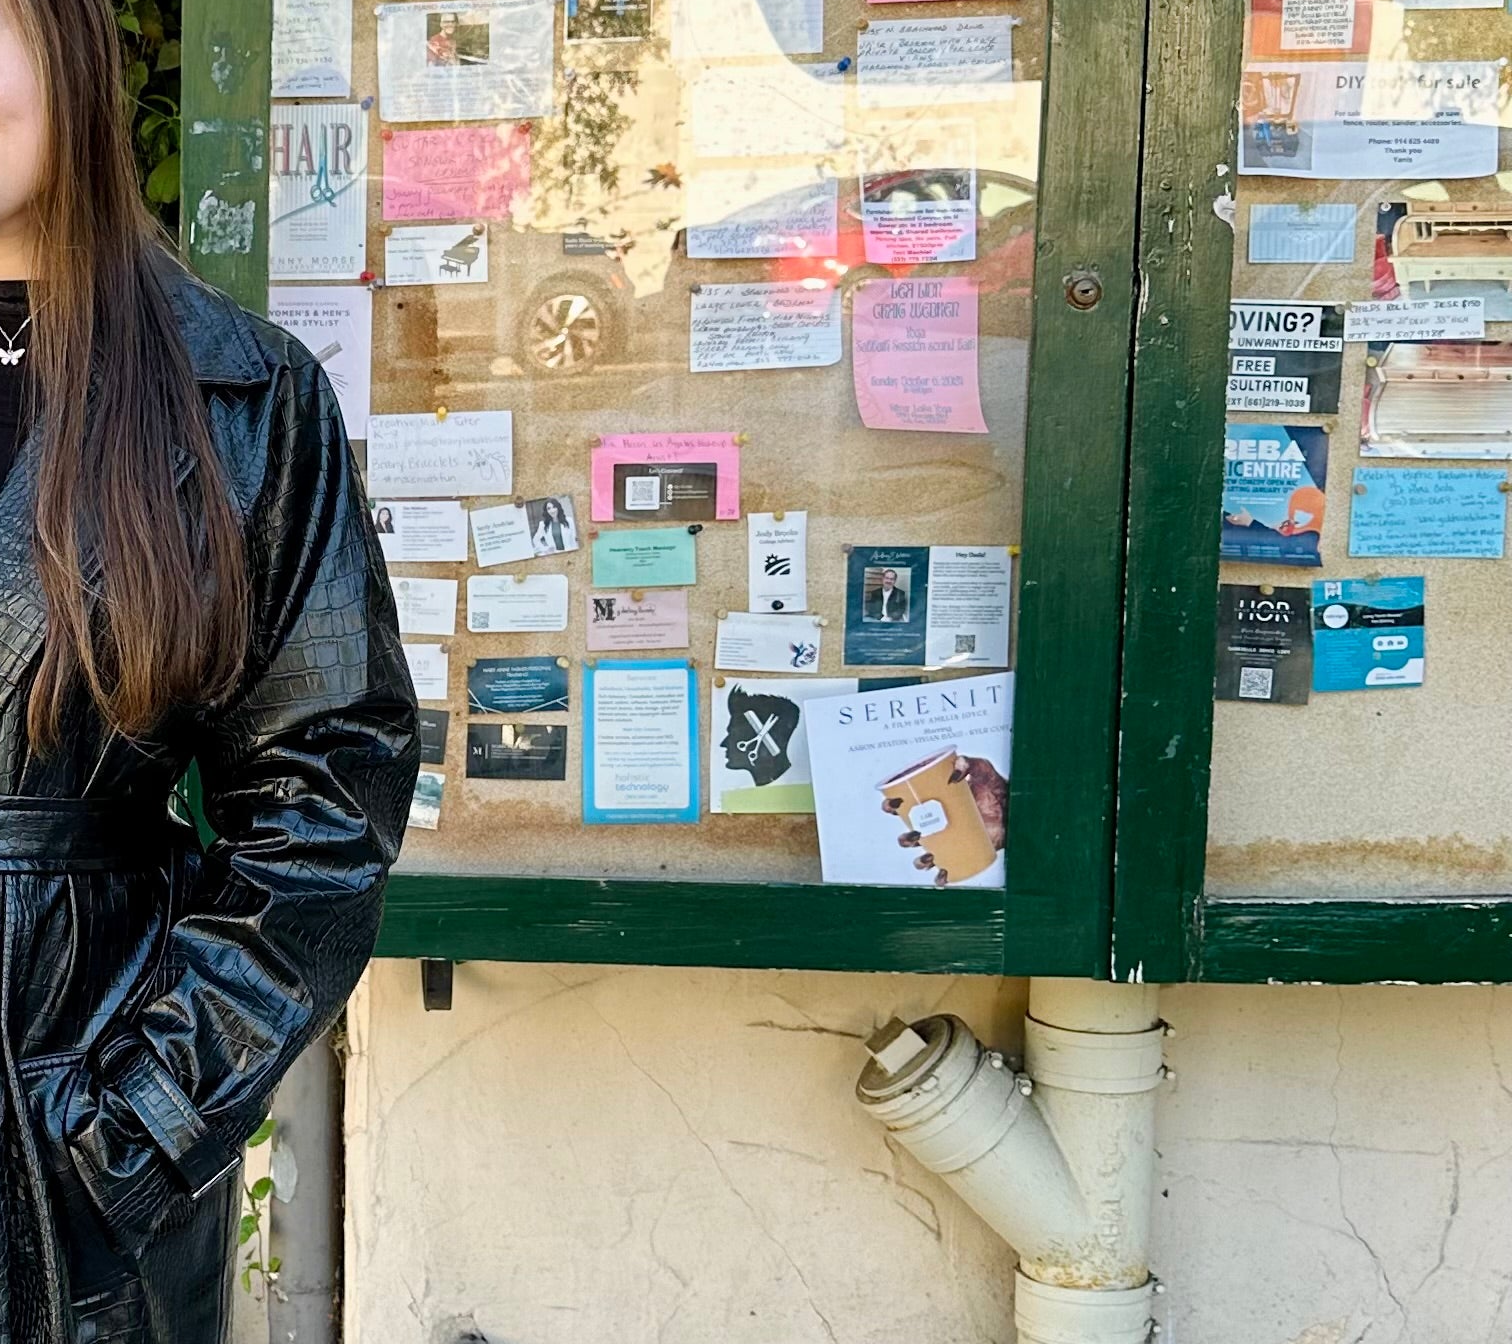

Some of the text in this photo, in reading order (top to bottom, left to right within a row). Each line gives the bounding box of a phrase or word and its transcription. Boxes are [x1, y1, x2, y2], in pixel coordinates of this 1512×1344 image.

[1336, 76, 1365, 89] DIY
[1417, 75, 1442, 88] for
[271, 123, 354, 176] HAIR
[906, 326, 926, 338] Yoga
[1238, 338, 1339, 349] UNWANTED ITEMS!
[1236, 360, 1272, 371] FREE
[1229, 379, 1304, 392] SULTATION
[1224, 439, 1306, 461] REBA
[839, 685, 1002, 725] SERENIT
[616, 783, 669, 793] technology
